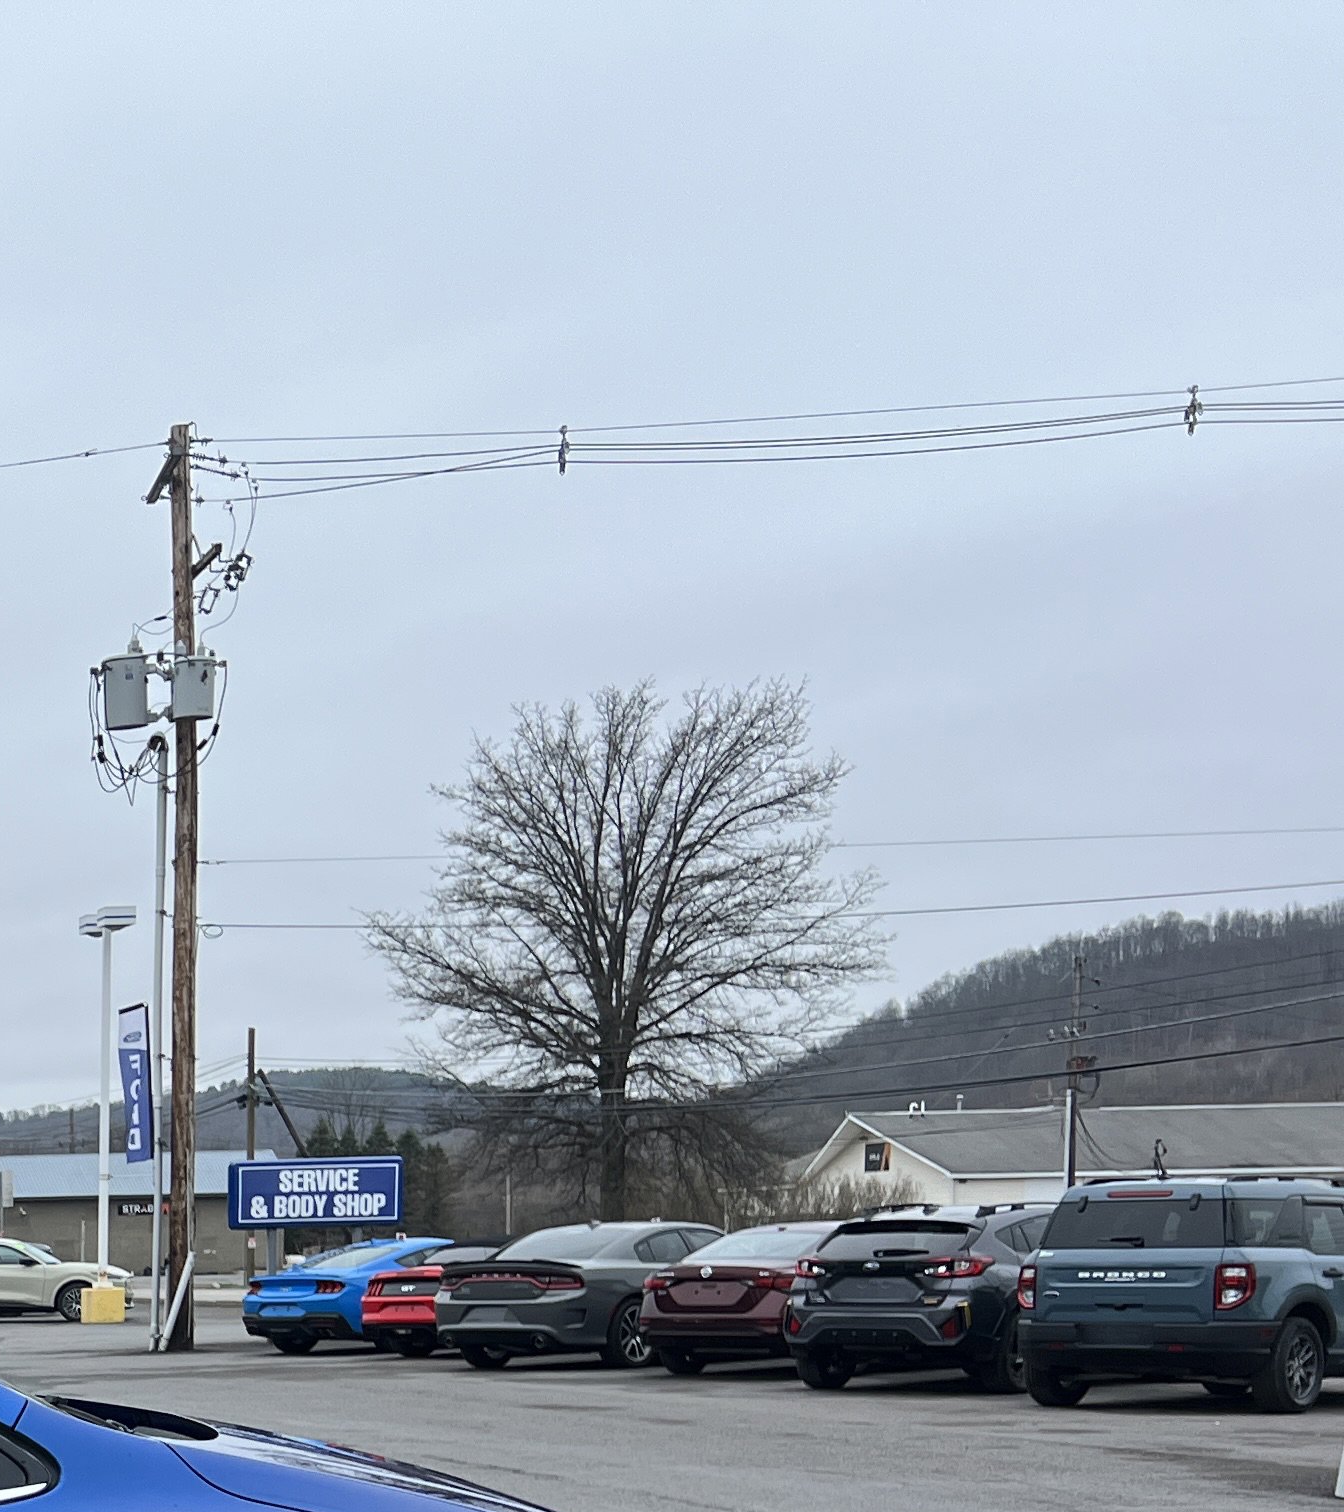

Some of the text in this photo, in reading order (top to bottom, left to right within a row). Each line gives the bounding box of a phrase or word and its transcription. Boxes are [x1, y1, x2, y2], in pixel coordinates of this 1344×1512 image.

[278, 1168, 359, 1193] SERVICE
[250, 1192, 386, 1219] & BODY SHOP
